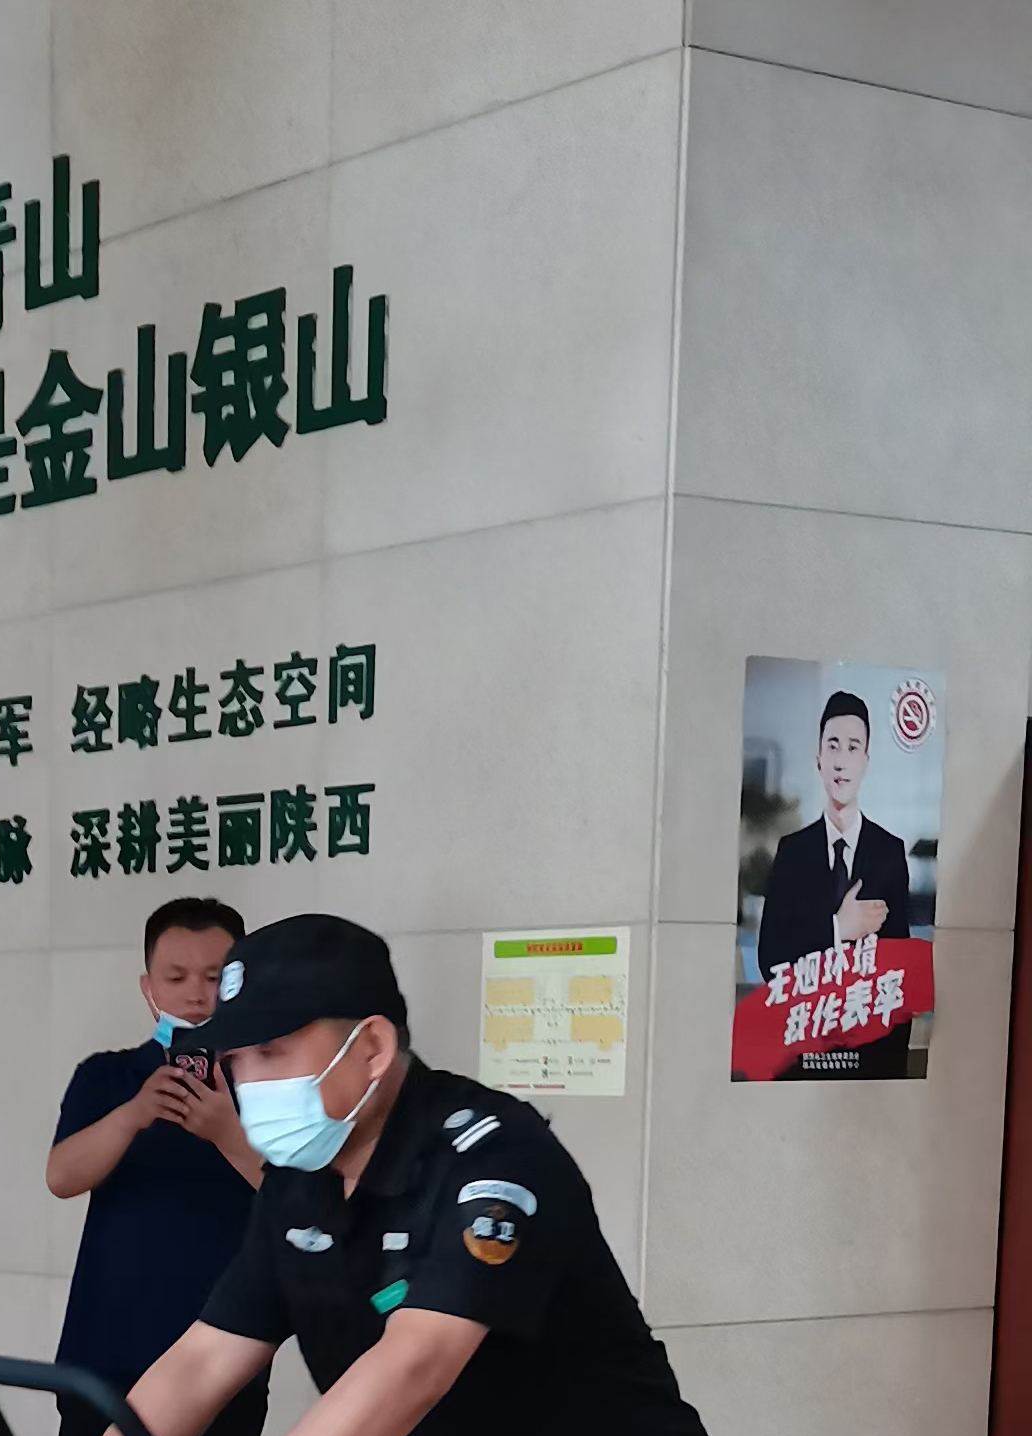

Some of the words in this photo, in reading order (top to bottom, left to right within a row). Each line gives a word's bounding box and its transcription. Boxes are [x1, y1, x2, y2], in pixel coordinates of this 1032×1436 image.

[70, 643, 376, 753] 经略生态空间
[70, 783, 375, 878] 深耕美丽陕西
[765, 934, 878, 1007] 无烟环境
